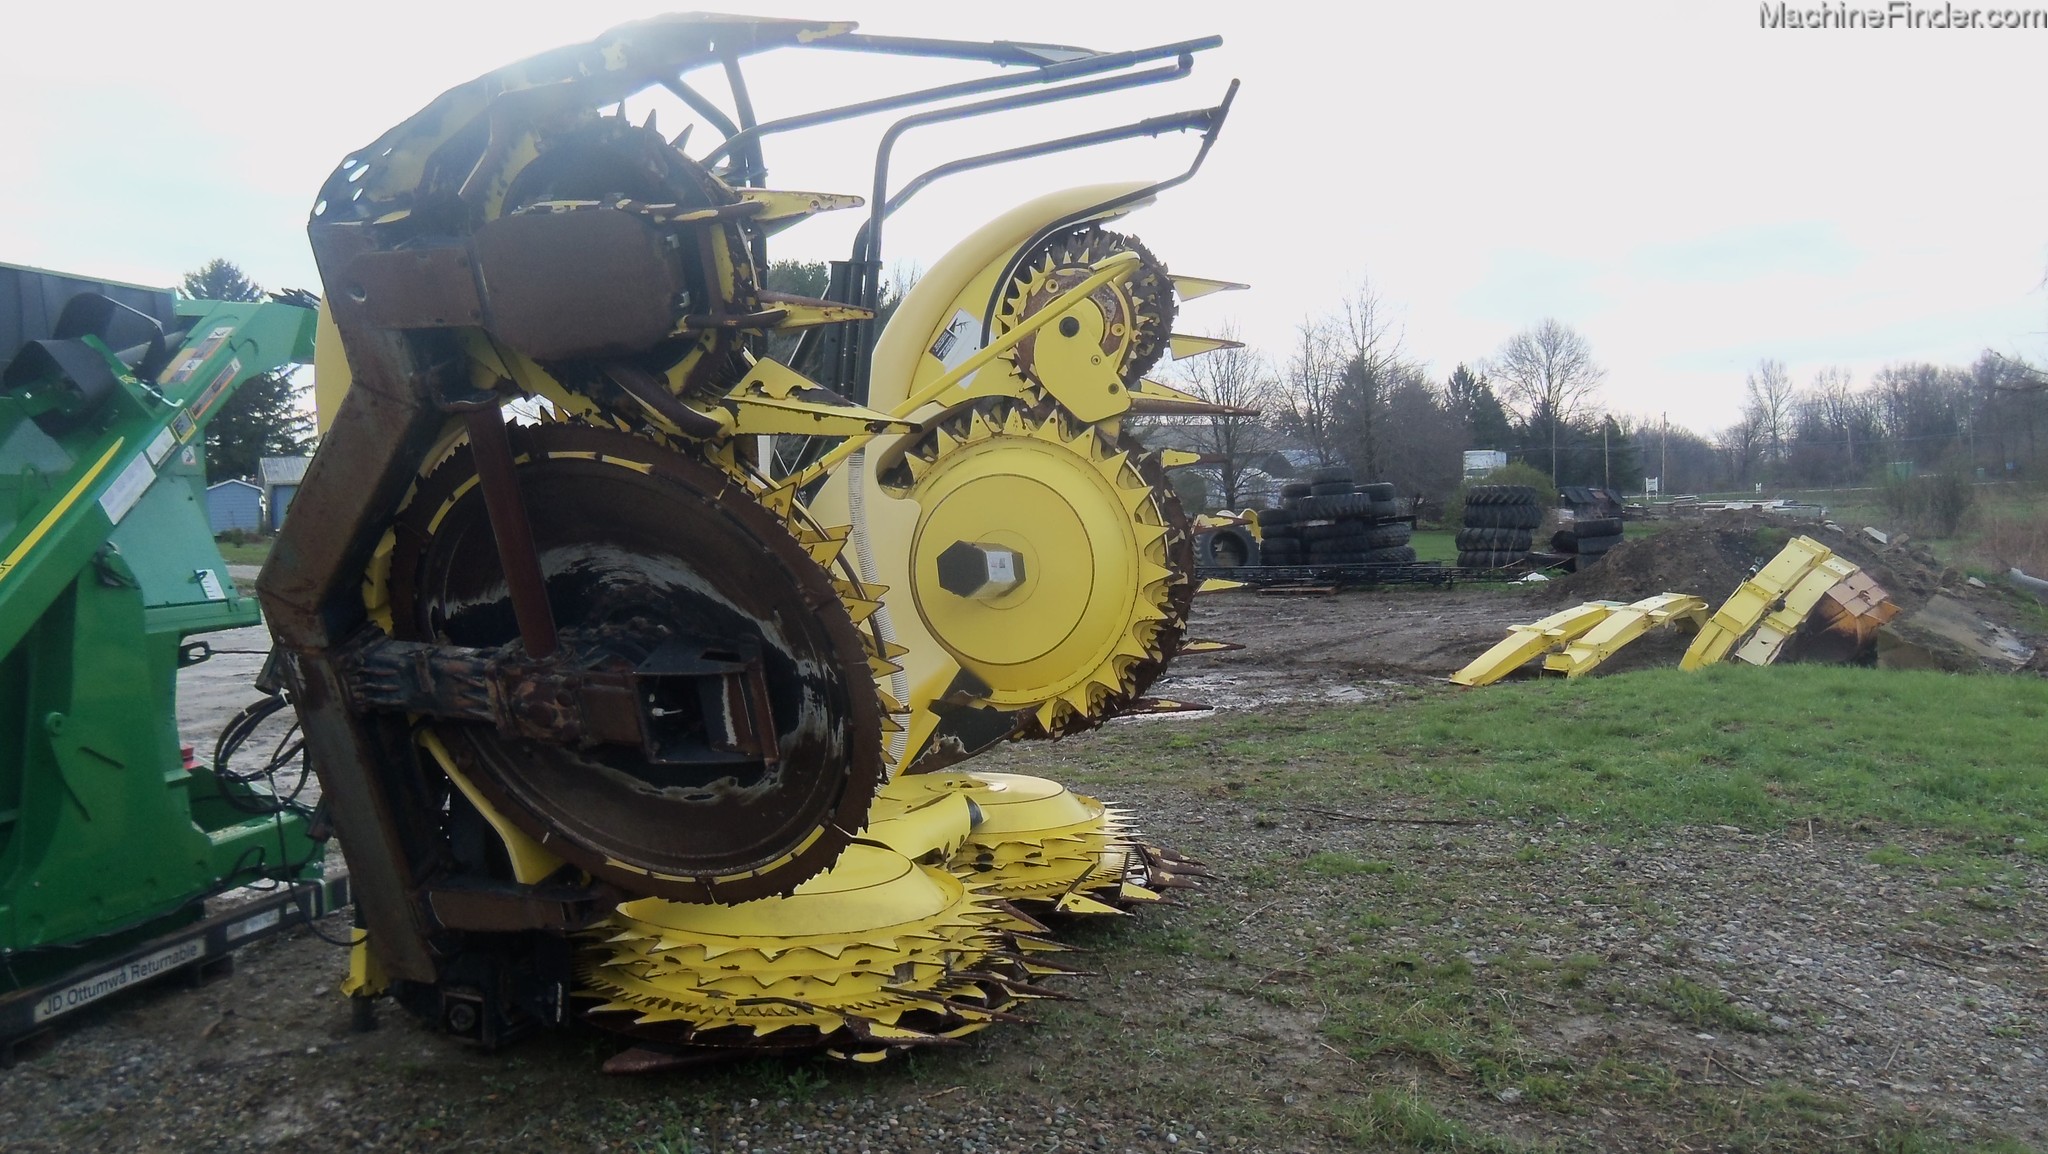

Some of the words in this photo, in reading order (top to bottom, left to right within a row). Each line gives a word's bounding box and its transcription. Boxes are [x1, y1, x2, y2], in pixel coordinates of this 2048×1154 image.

[44, 995, 62, 1015] JD
[67, 971, 127, 1005] Ottumwa
[131, 944, 197, 980] Returnable
